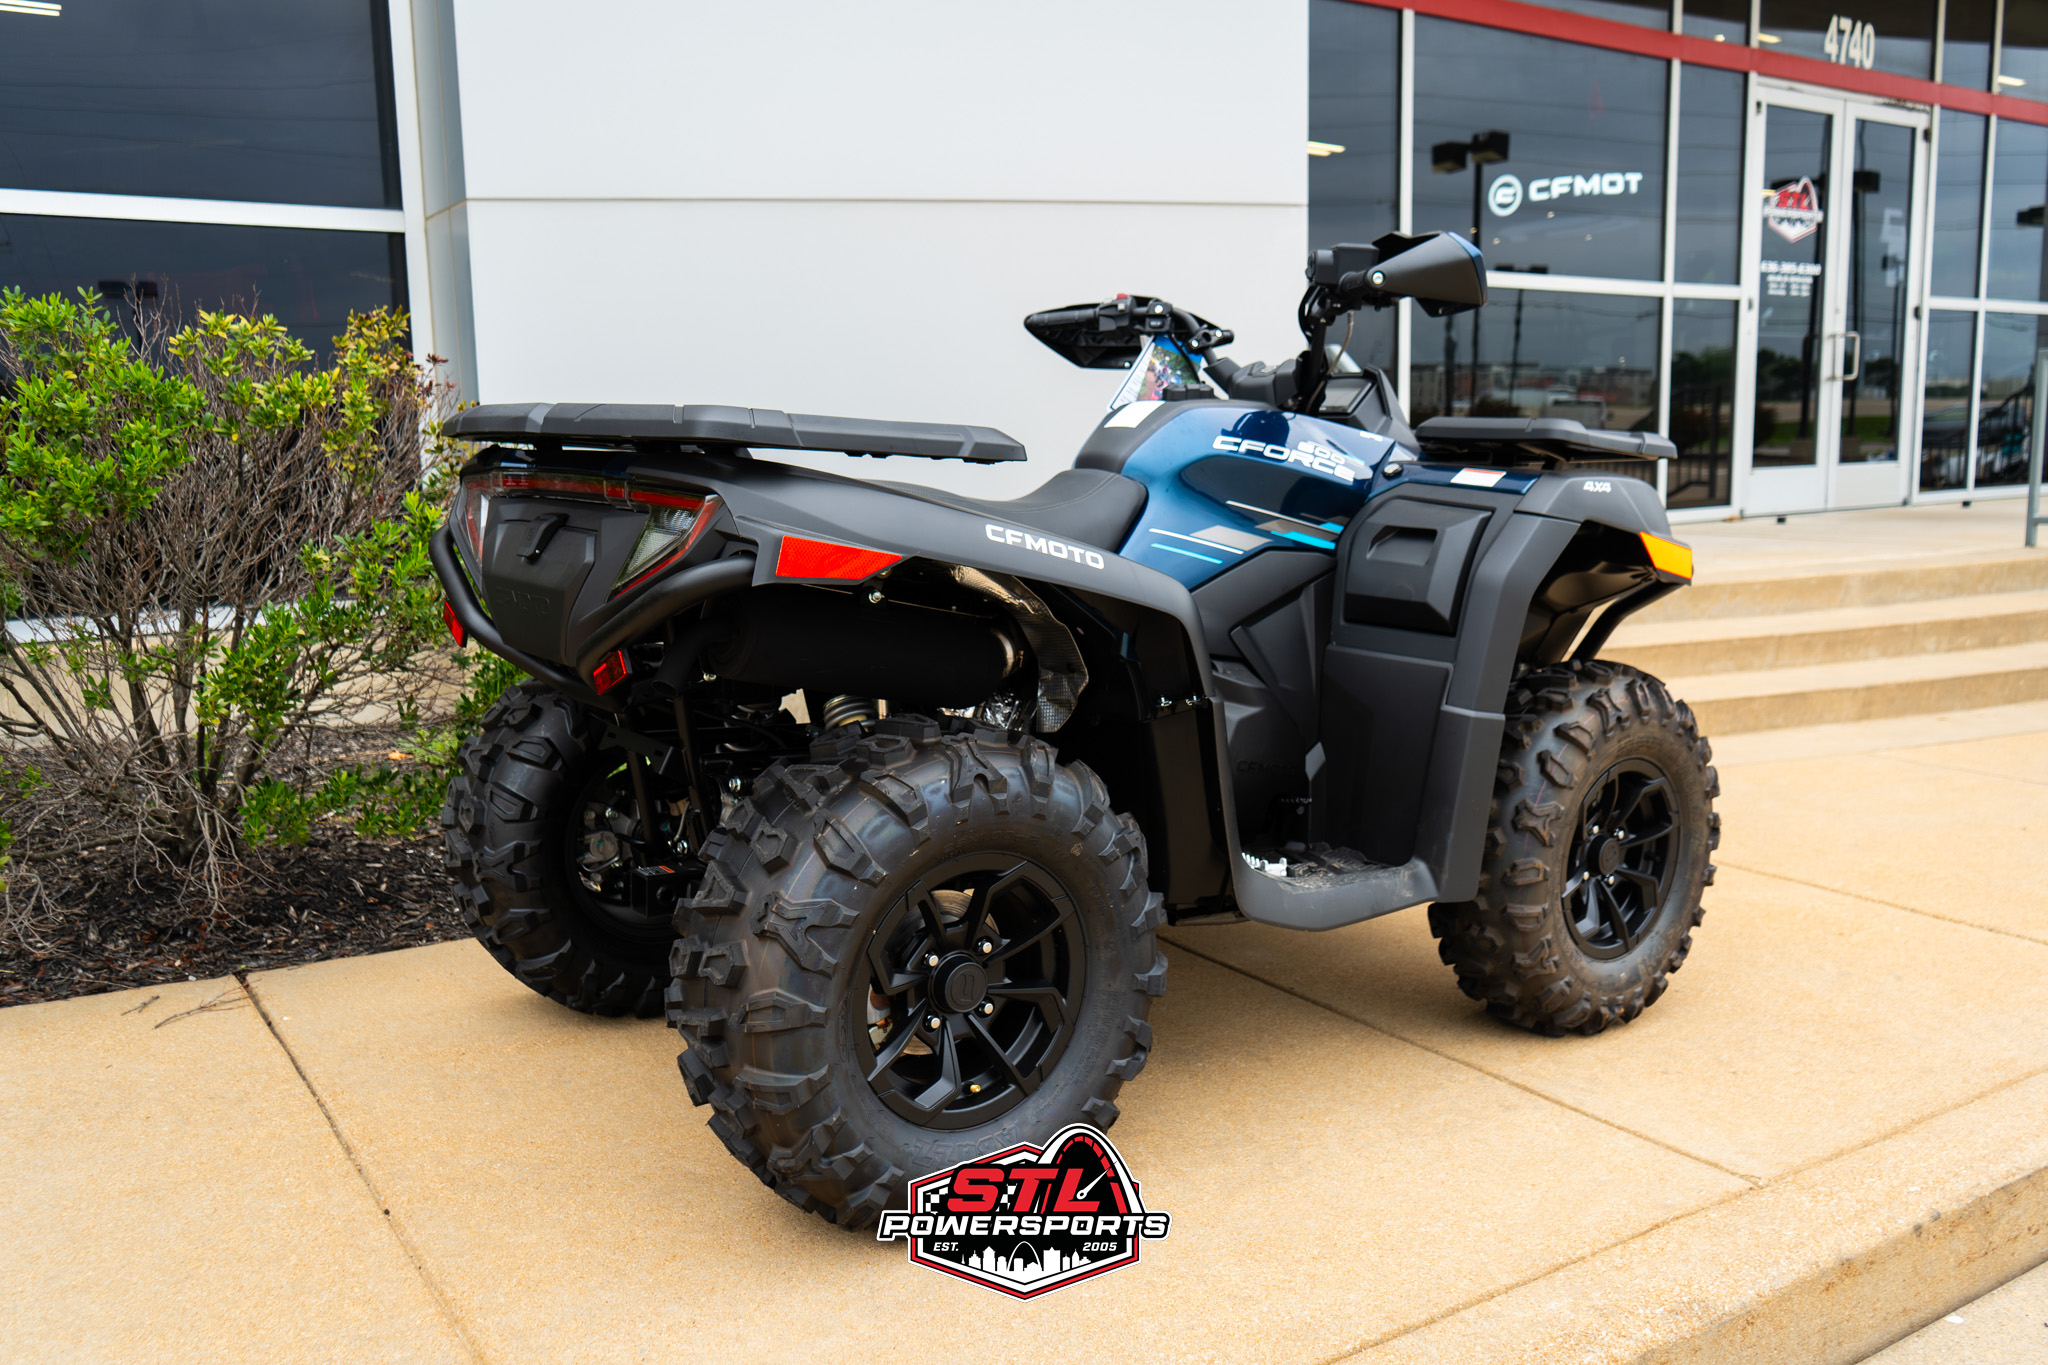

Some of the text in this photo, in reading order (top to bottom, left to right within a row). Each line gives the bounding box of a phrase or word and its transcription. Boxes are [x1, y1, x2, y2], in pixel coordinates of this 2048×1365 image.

[1824, 13, 1875, 70] 4740
[1528, 172, 1643, 202] CFMOT
[1777, 190, 1809, 211] STL
[1213, 435, 1355, 482] CFORCE
[985, 523, 1105, 570] CFMOTO
